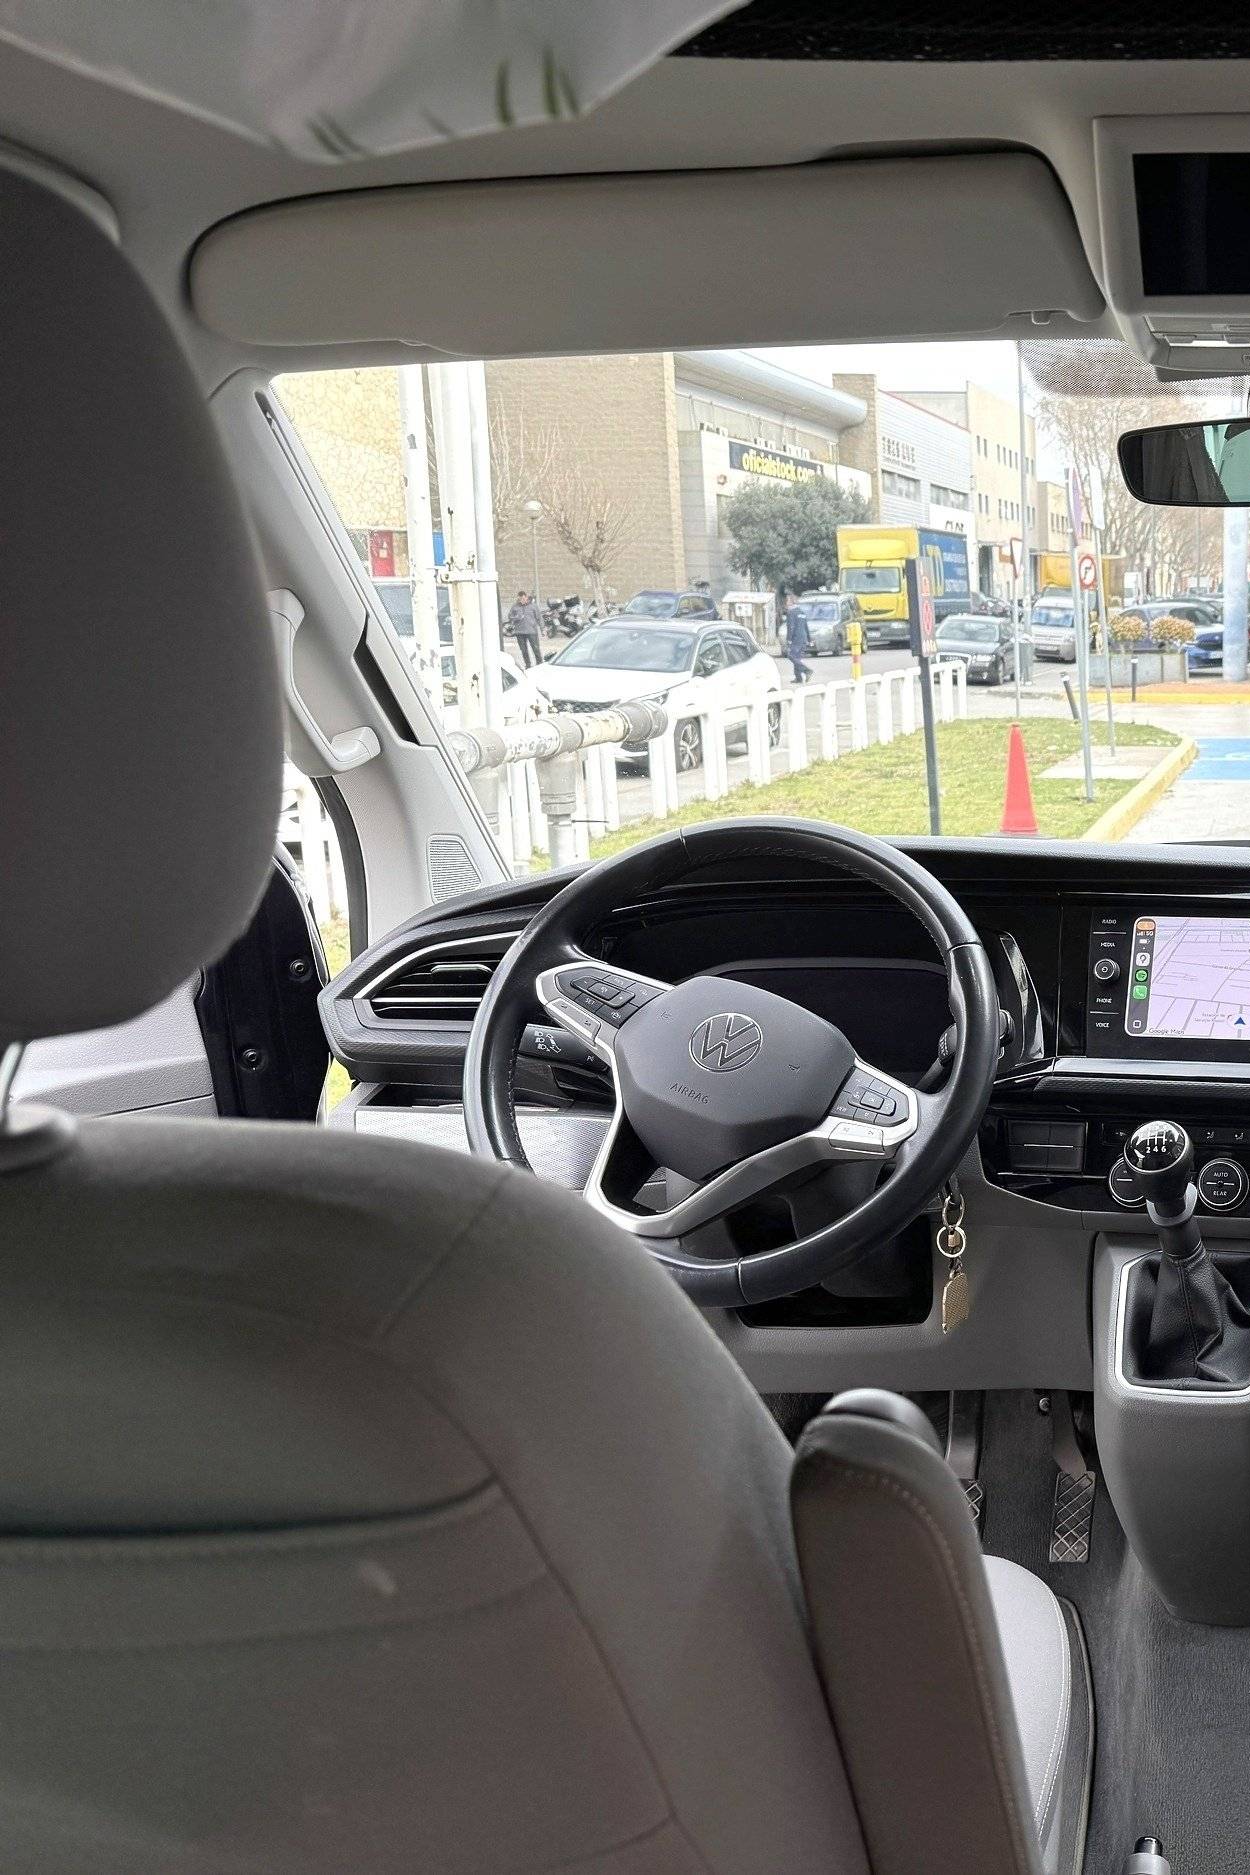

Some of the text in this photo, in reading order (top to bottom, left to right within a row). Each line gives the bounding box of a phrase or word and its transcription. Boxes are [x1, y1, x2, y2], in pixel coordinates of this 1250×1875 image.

[1148, 1027, 1185, 1036] Google Maps
[670, 1082, 711, 1105] AIRBAG
[1161, 1145, 1167, 1153] 6
